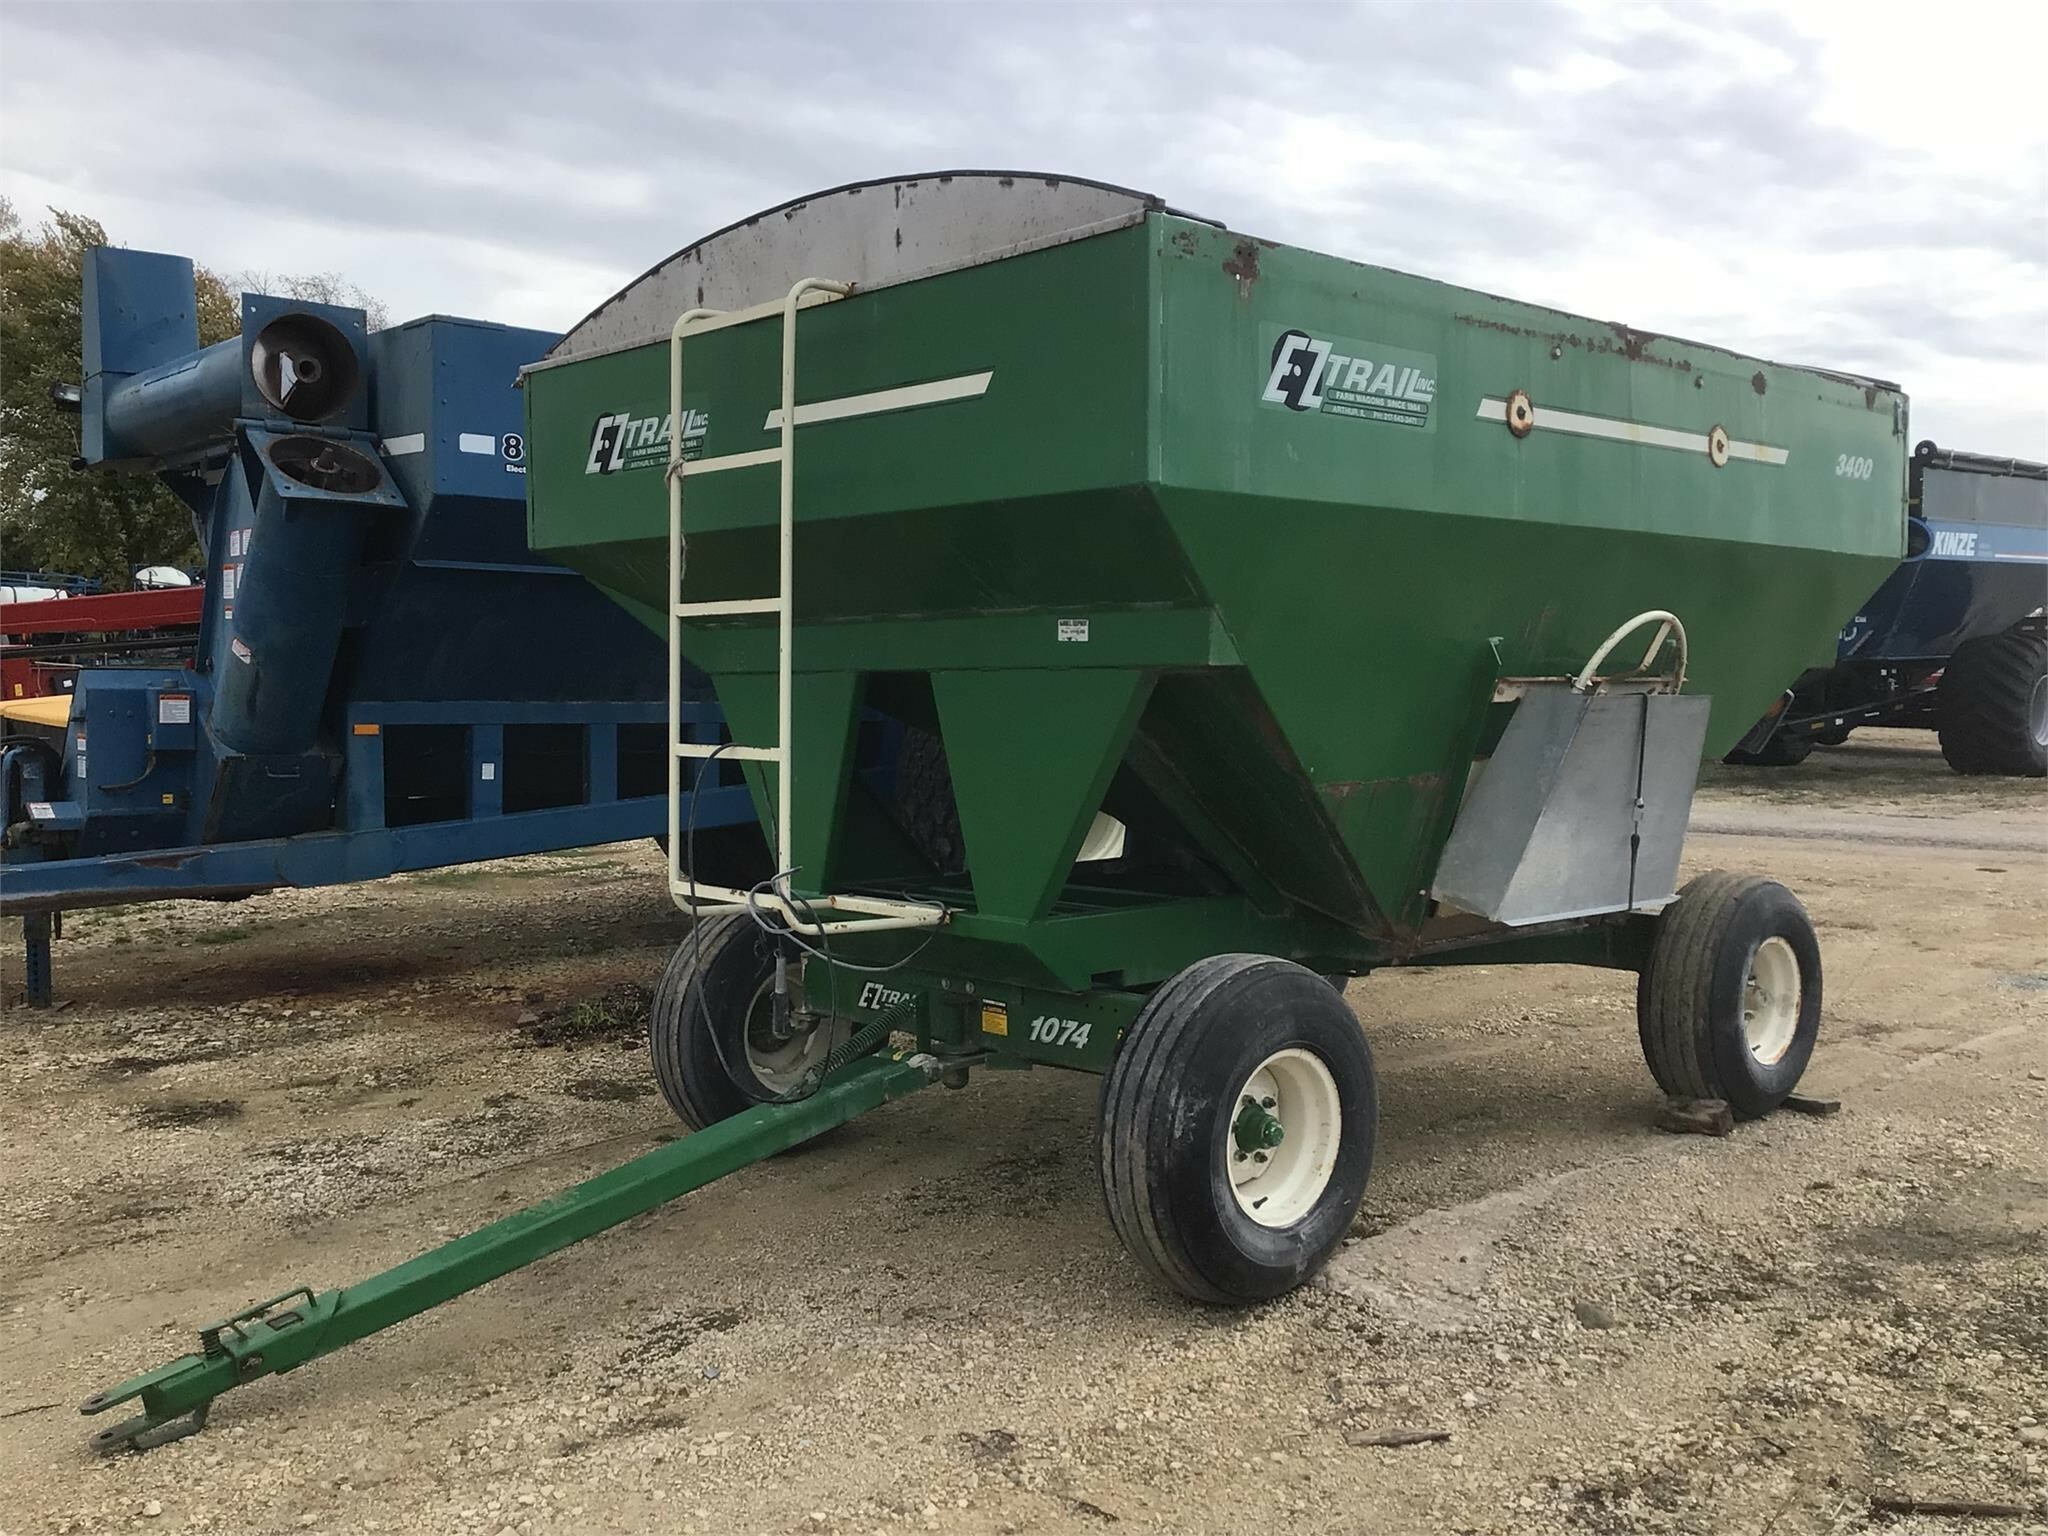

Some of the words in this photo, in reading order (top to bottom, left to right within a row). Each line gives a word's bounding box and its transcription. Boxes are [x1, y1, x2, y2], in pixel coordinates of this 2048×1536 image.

[1325, 353, 1434, 402] TRAIL
[1336, 391, 1355, 401] FARM
[1356, 394, 1385, 406] WAGONS
[1386, 399, 1406, 410] SINCE
[502, 433, 526, 461] 8
[1835, 453, 1873, 480] 3400
[1931, 531, 1978, 557] KINZE
[1029, 1016, 1093, 1049] 1074
